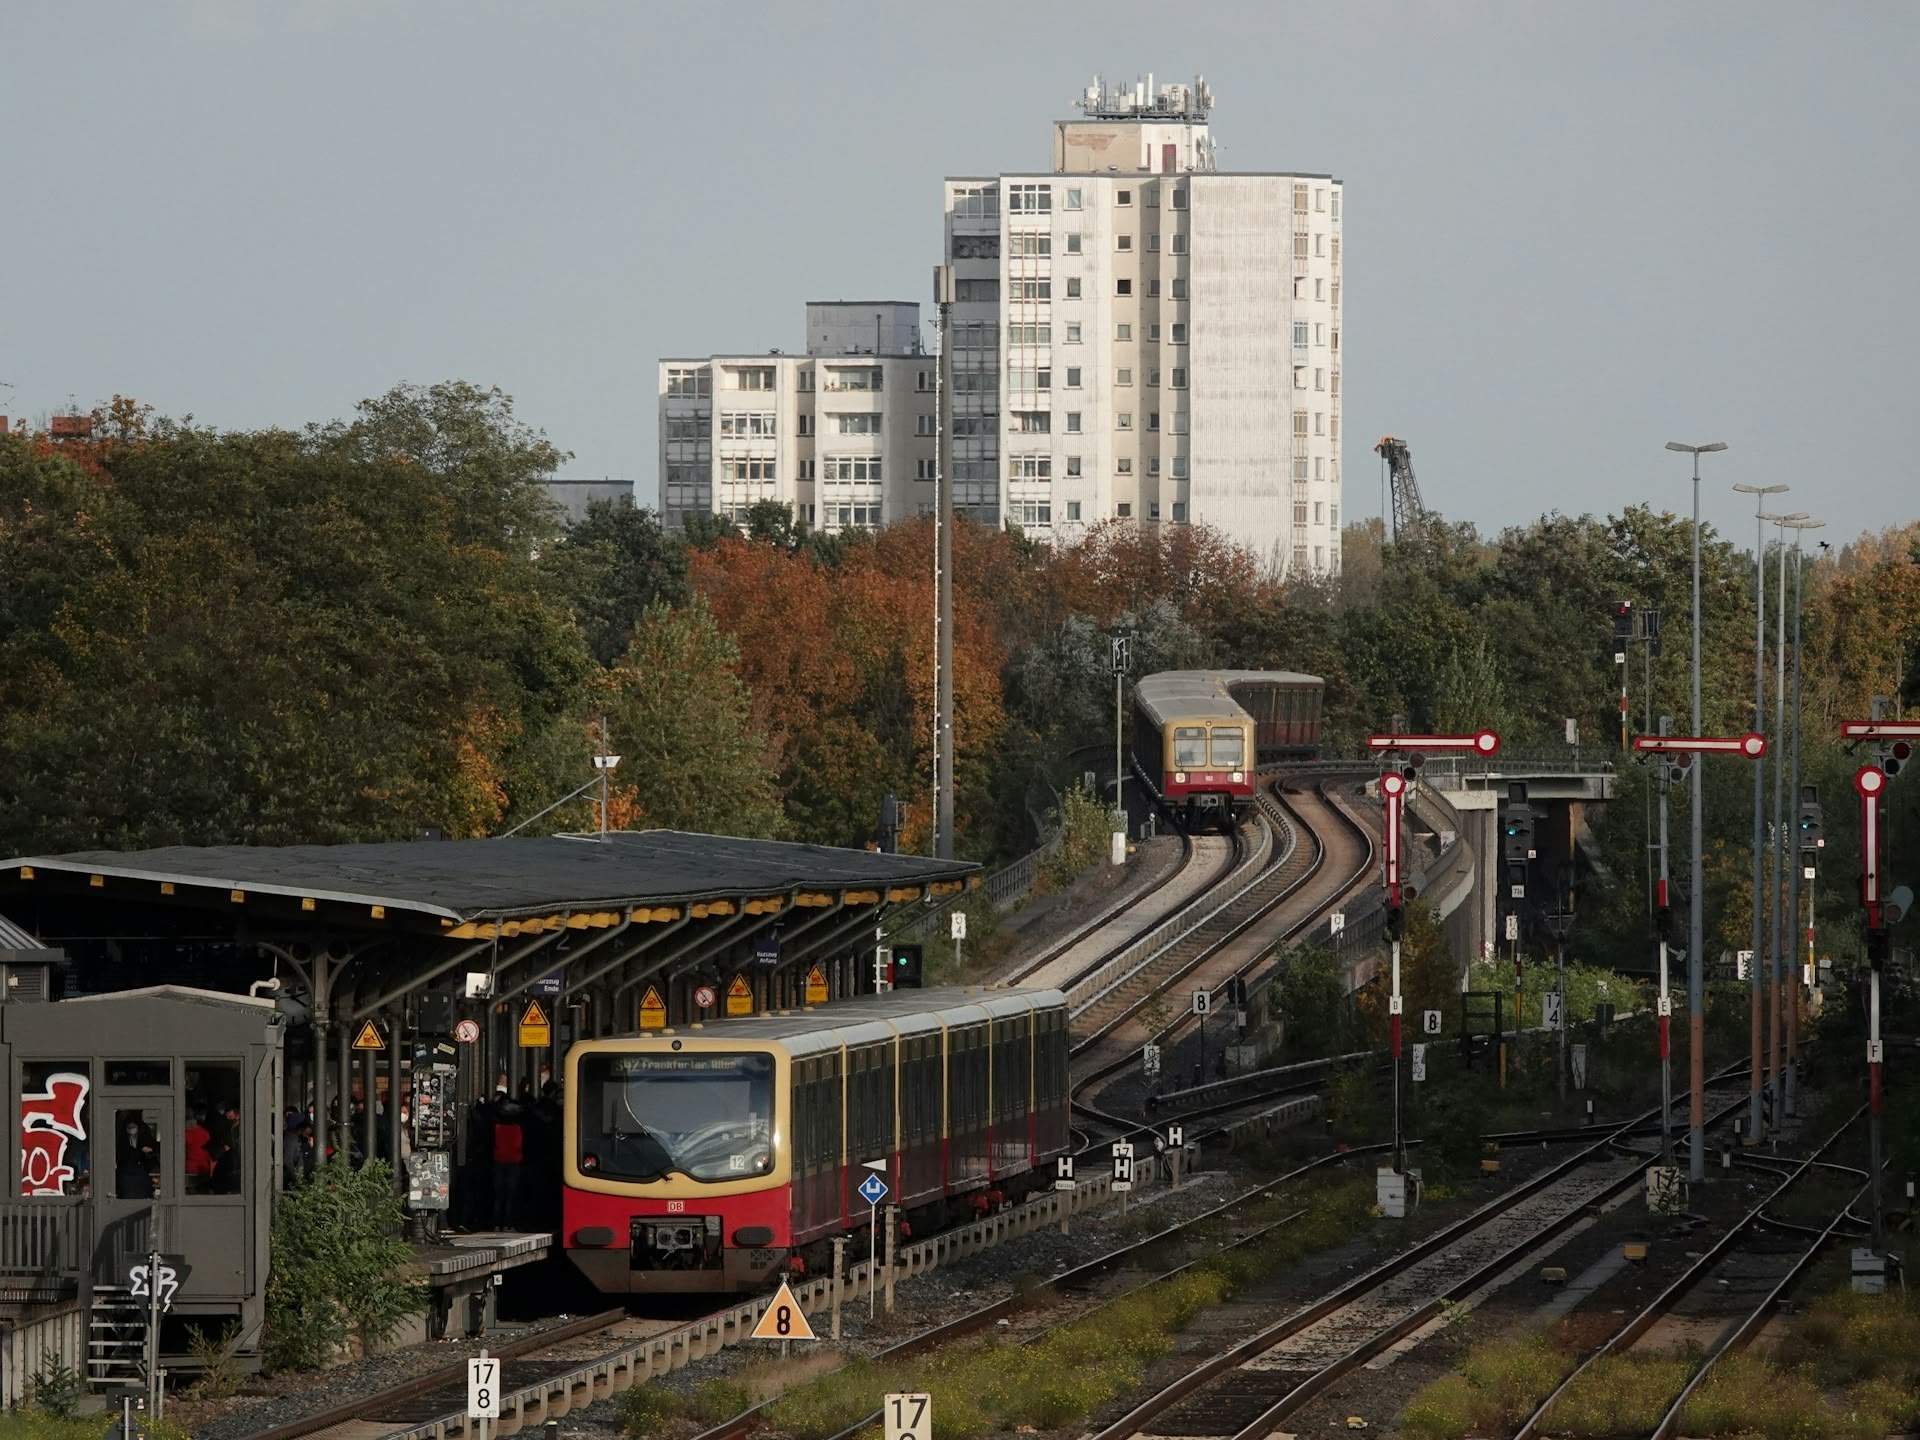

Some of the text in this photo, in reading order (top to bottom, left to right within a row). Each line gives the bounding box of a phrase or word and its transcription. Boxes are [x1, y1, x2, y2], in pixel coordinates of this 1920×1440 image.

[1197, 995, 1205, 1011] 8
[1546, 994, 1561, 1009] 17
[1429, 1014, 1437, 1031] 8
[1549, 1010, 1559, 1025] 4
[1872, 1045, 1879, 1058] F
[1169, 1127, 1183, 1145] H
[732, 1156, 745, 1168] 12
[1057, 1157, 1073, 1177] H
[1114, 1159, 1130, 1179] H
[669, 1202, 684, 1212] DB
[776, 1305, 791, 1335] 8
[473, 1364, 495, 1385] 17
[478, 1389, 490, 1409] 8
[892, 1398, 928, 1430] 17
